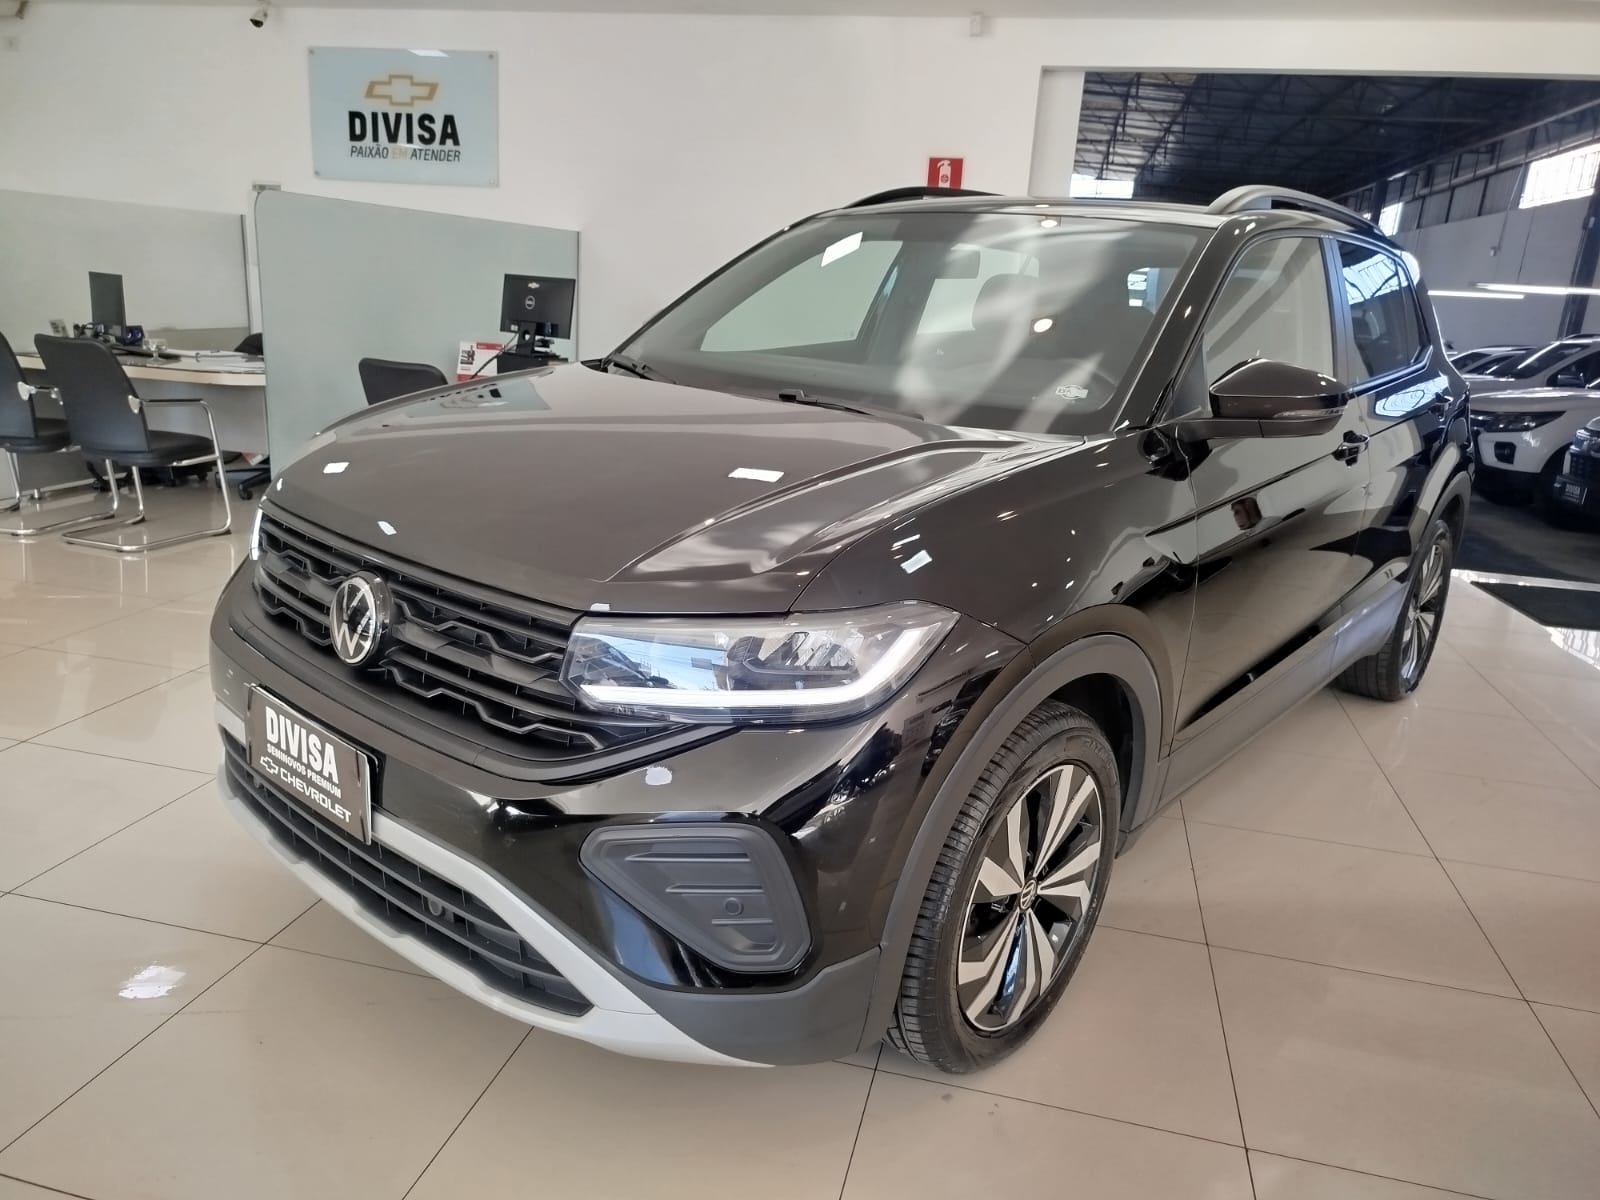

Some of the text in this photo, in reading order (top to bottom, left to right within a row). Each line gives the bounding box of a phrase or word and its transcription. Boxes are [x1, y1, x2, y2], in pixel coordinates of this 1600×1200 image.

[348, 110, 461, 146] DIVISA
[350, 144, 461, 162] PAIXÃO EM ATENDER
[265, 706, 339, 784] DIVISA
[266, 743, 342, 799] SEMINOVOS PREMIUM
[280, 767, 351, 823] CHEVROLET
